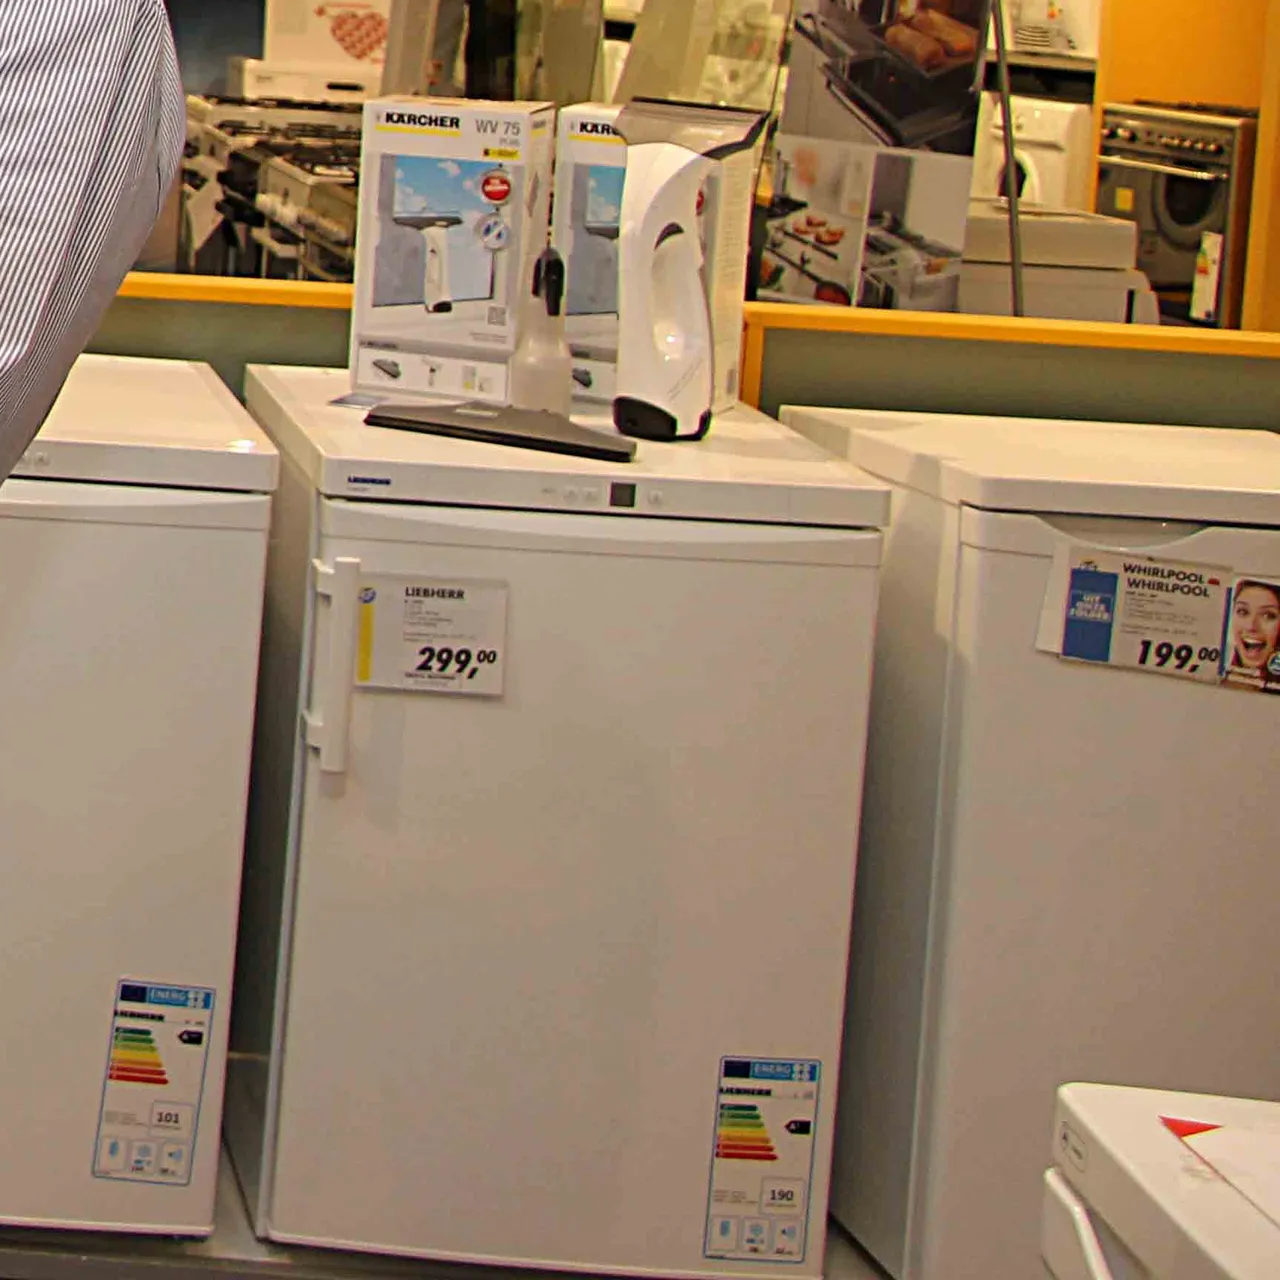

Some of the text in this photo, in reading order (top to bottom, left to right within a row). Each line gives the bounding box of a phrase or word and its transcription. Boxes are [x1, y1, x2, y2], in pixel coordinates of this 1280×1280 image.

[474, 118, 500, 135] WV
[503, 120, 522, 137] 75
[1123, 562, 1205, 584] WHIRLPOOL
[404, 586, 465, 600] LIEBHERR
[1127, 577, 1210, 599] WHIRLPOOL
